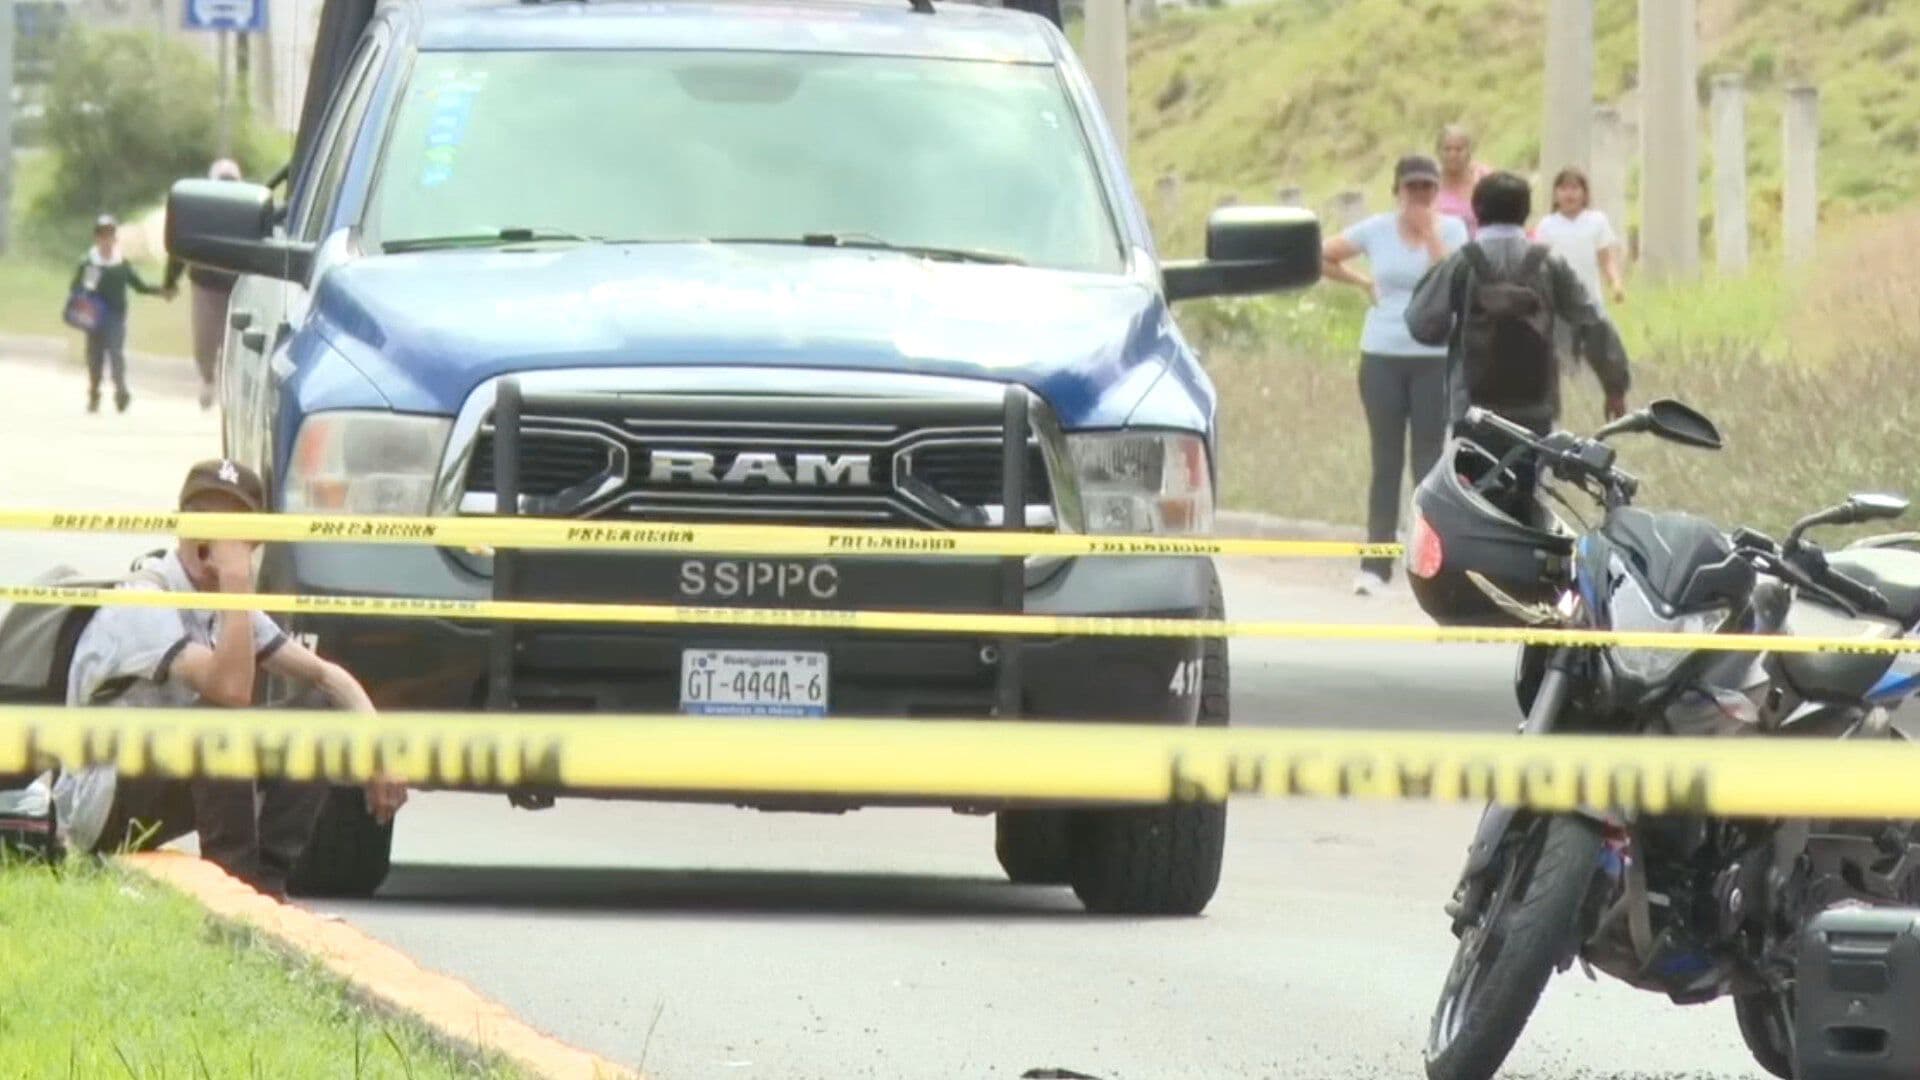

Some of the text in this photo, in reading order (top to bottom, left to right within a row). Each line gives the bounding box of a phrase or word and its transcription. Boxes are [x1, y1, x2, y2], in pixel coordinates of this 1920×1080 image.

[651, 450, 871, 485] RAM
[680, 560, 840, 598] SSPPC
[688, 669, 822, 702] GT-444A-6
